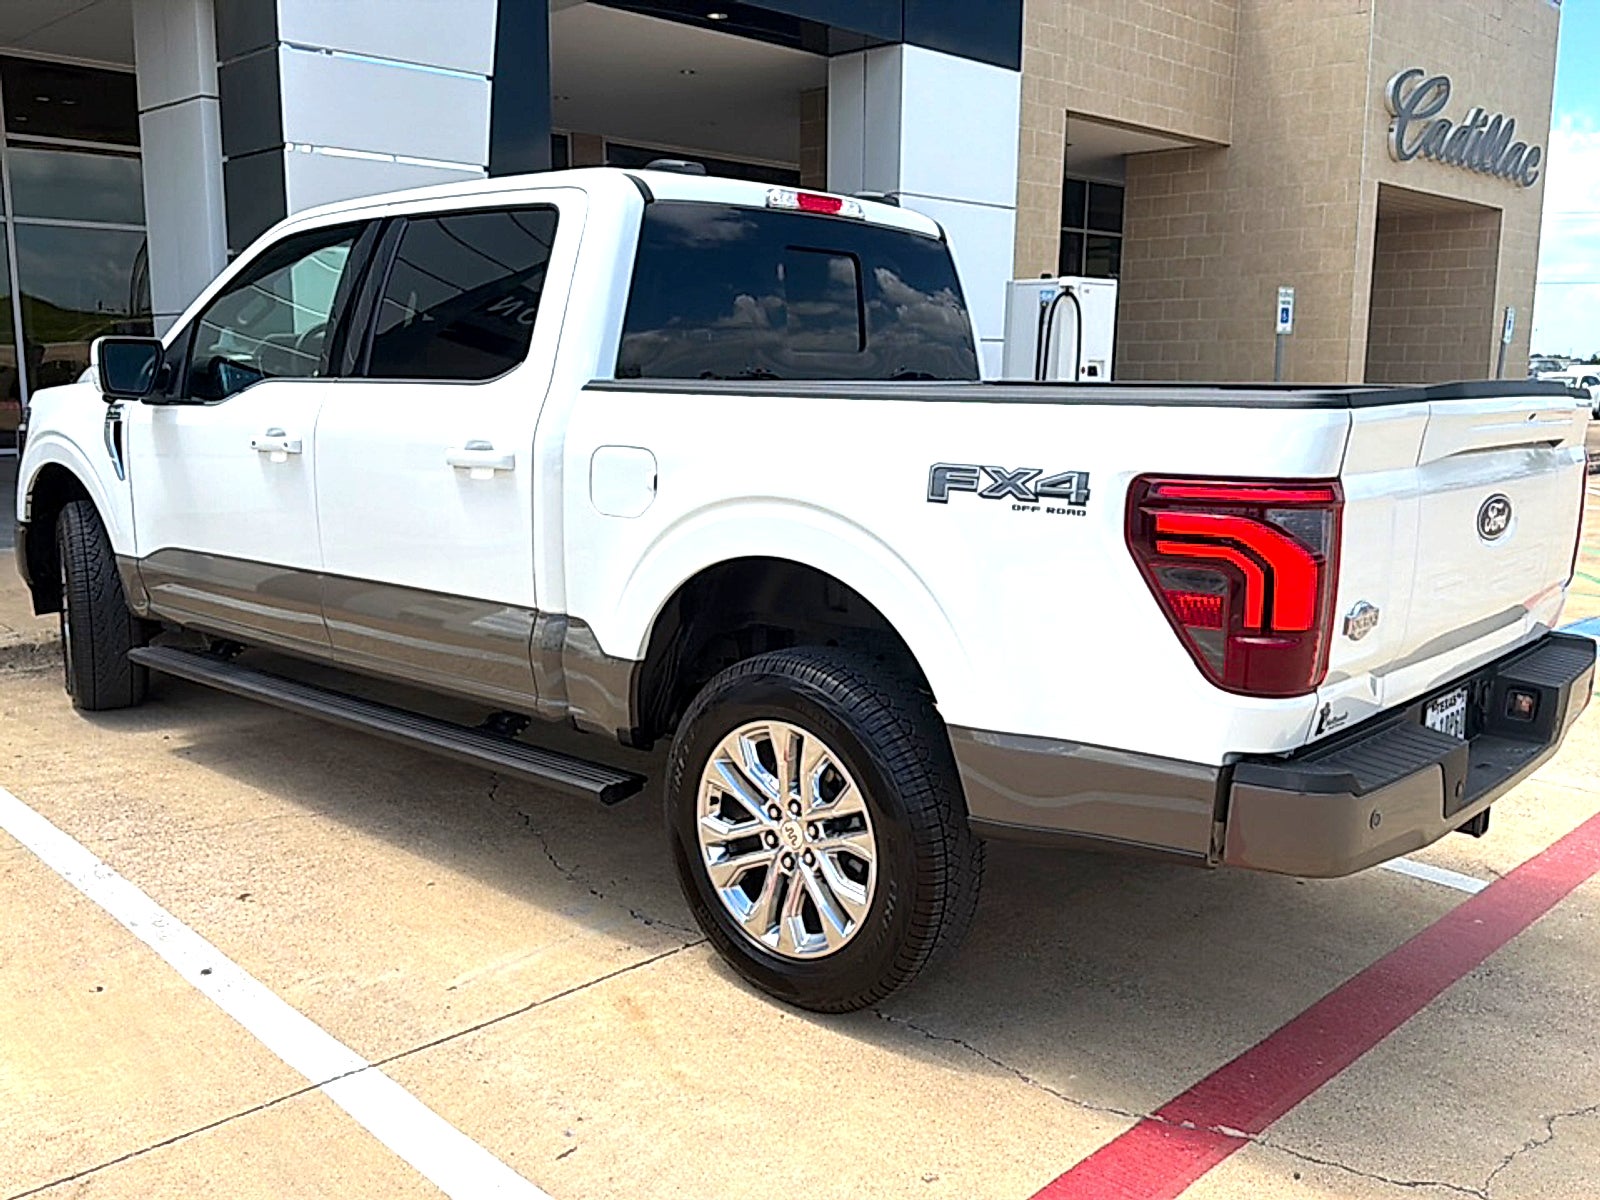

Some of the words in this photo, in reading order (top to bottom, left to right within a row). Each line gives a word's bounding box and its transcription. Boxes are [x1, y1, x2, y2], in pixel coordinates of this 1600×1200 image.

[1385, 67, 1542, 188] Cadillac
[926, 462, 1091, 507] FX4
[1011, 503, 1041, 513] OFF
[1046, 506, 1087, 517] ROAD
[1482, 499, 1510, 535] Ford
